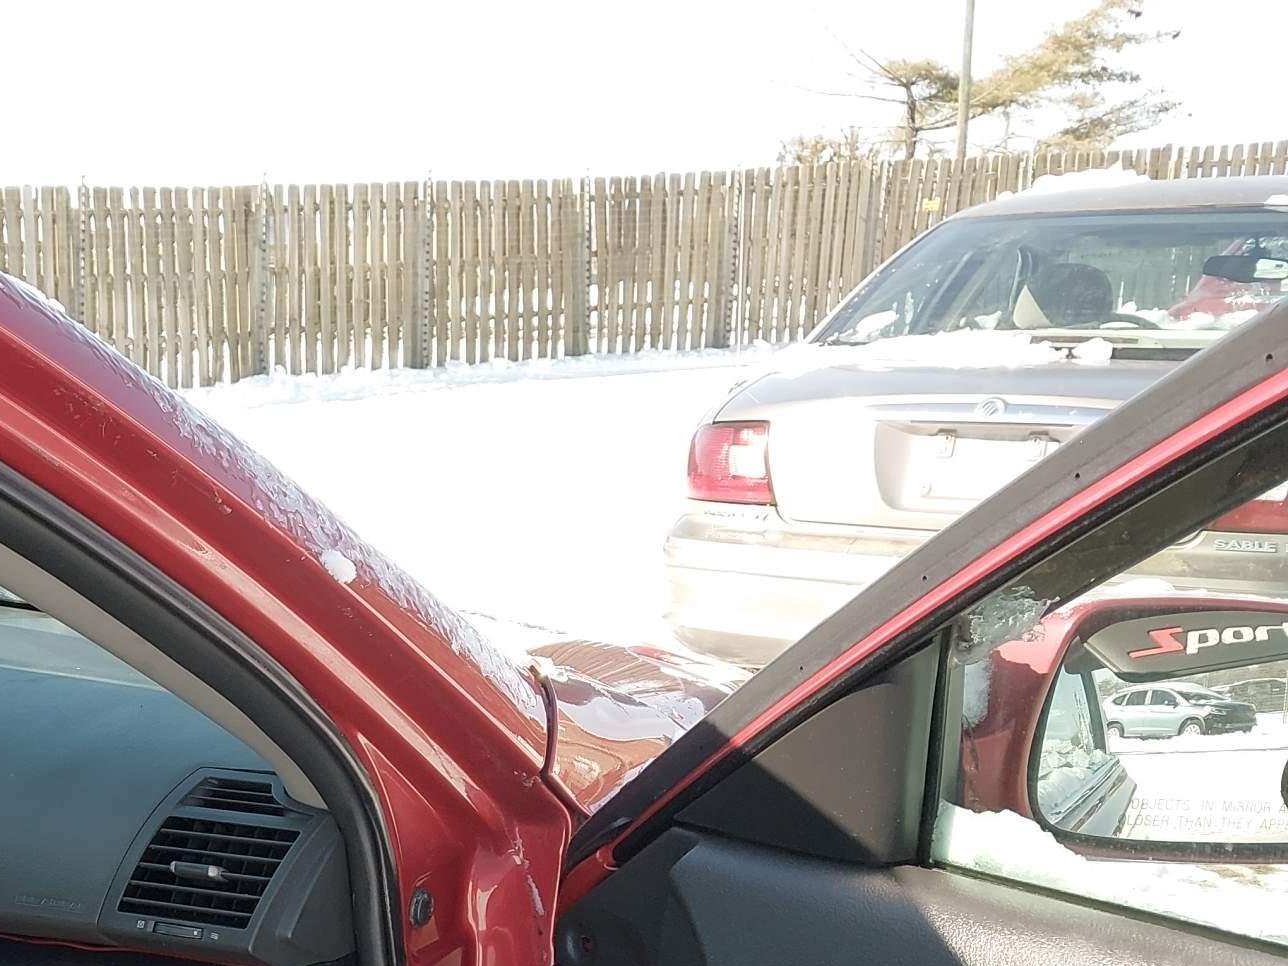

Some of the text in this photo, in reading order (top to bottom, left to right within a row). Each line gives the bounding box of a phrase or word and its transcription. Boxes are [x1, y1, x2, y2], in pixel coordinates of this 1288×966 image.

[1213, 538, 1278, 554] SABLE
[1129, 797, 1191, 811] OBJECTS
[1200, 799, 1215, 812] IN
[1221, 799, 1272, 814] MIRROR
[1177, 816, 1212, 828] THAN
[1220, 817, 1252, 829] THEY
